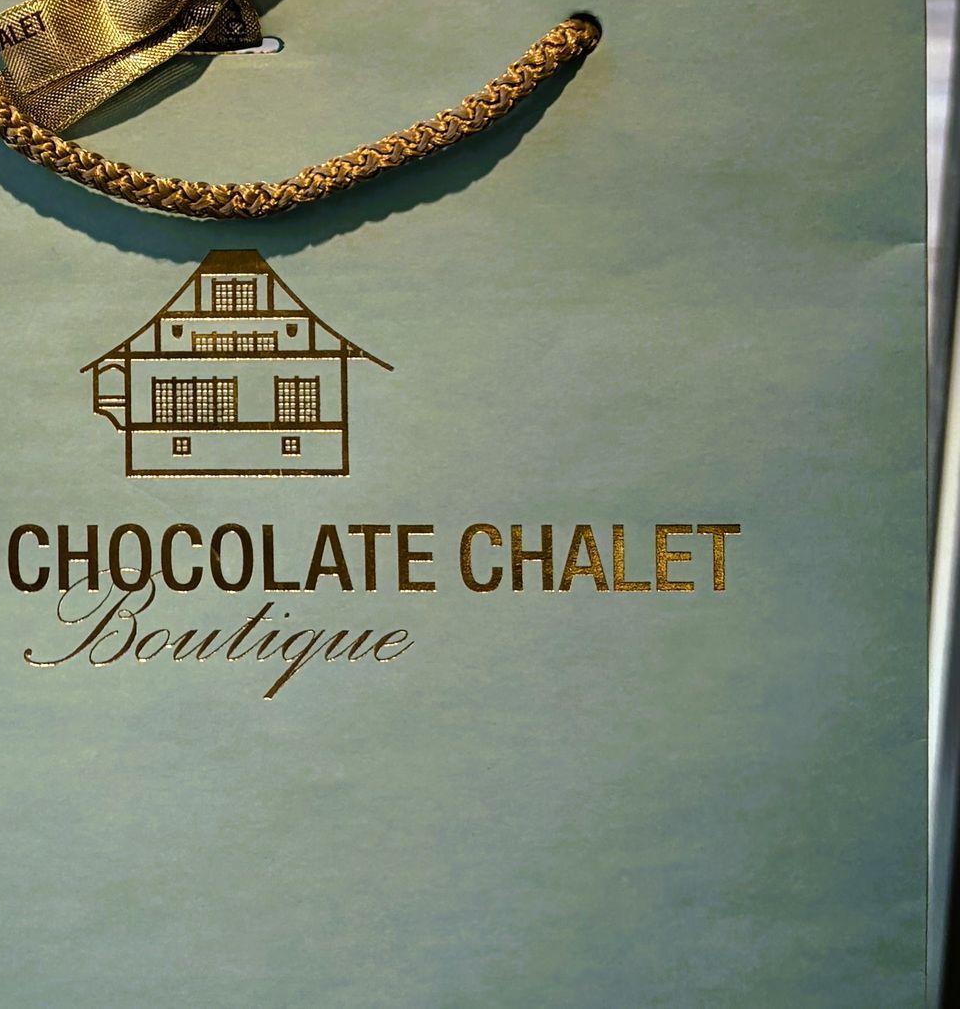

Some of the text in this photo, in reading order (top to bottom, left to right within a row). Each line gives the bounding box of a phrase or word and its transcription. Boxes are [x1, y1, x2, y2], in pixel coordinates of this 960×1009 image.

[7, 523, 437, 594] CHOCOLATE
[459, 523, 742, 594] CHALET
[24, 566, 415, 701] Boutique
